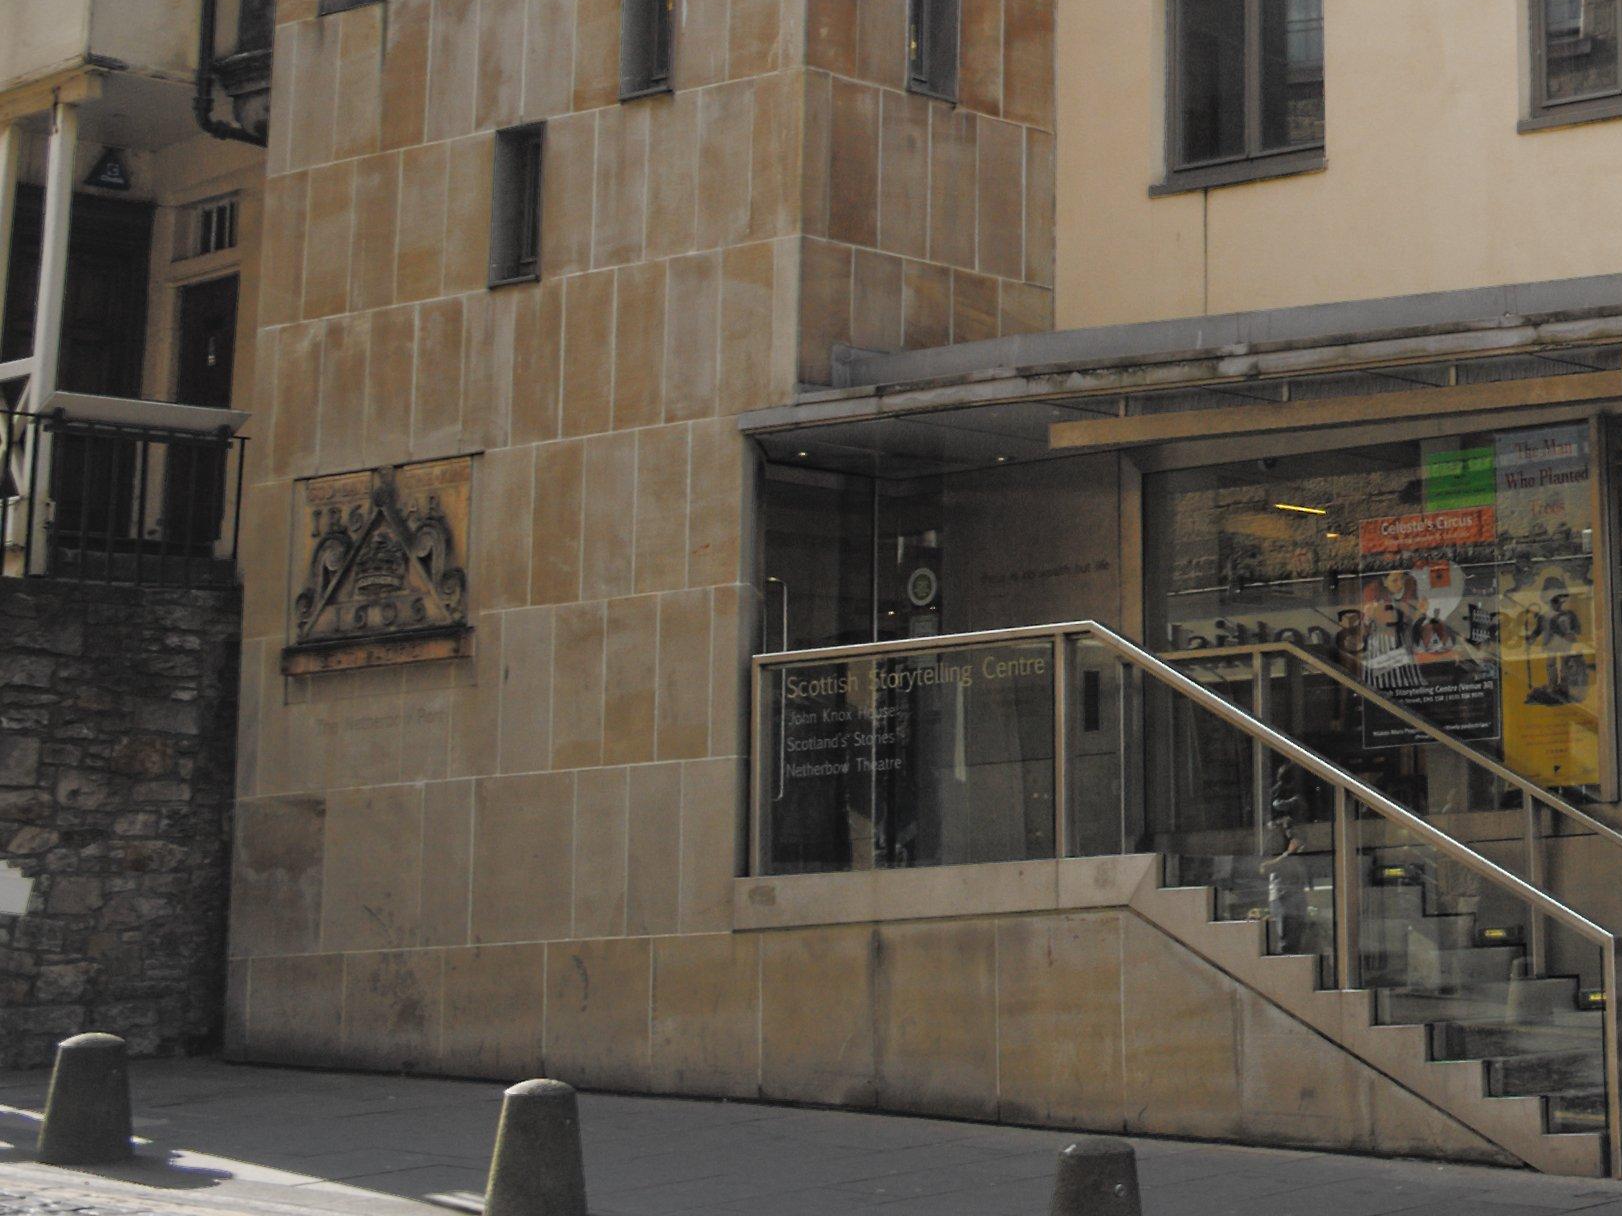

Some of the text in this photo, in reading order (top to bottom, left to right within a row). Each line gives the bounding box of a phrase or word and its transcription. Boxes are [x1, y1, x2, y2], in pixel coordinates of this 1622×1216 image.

[1504, 467, 1534, 491] Who
[1538, 463, 1589, 488] Planted
[1380, 515, 1473, 536] Celeste's Circus
[786, 656, 1046, 699] Scottish Storytelling Centre
[787, 705, 894, 727] John Knox House
[786, 731, 896, 754] Scotland's Stories
[785, 756, 903, 779] Netherbow Theatre
